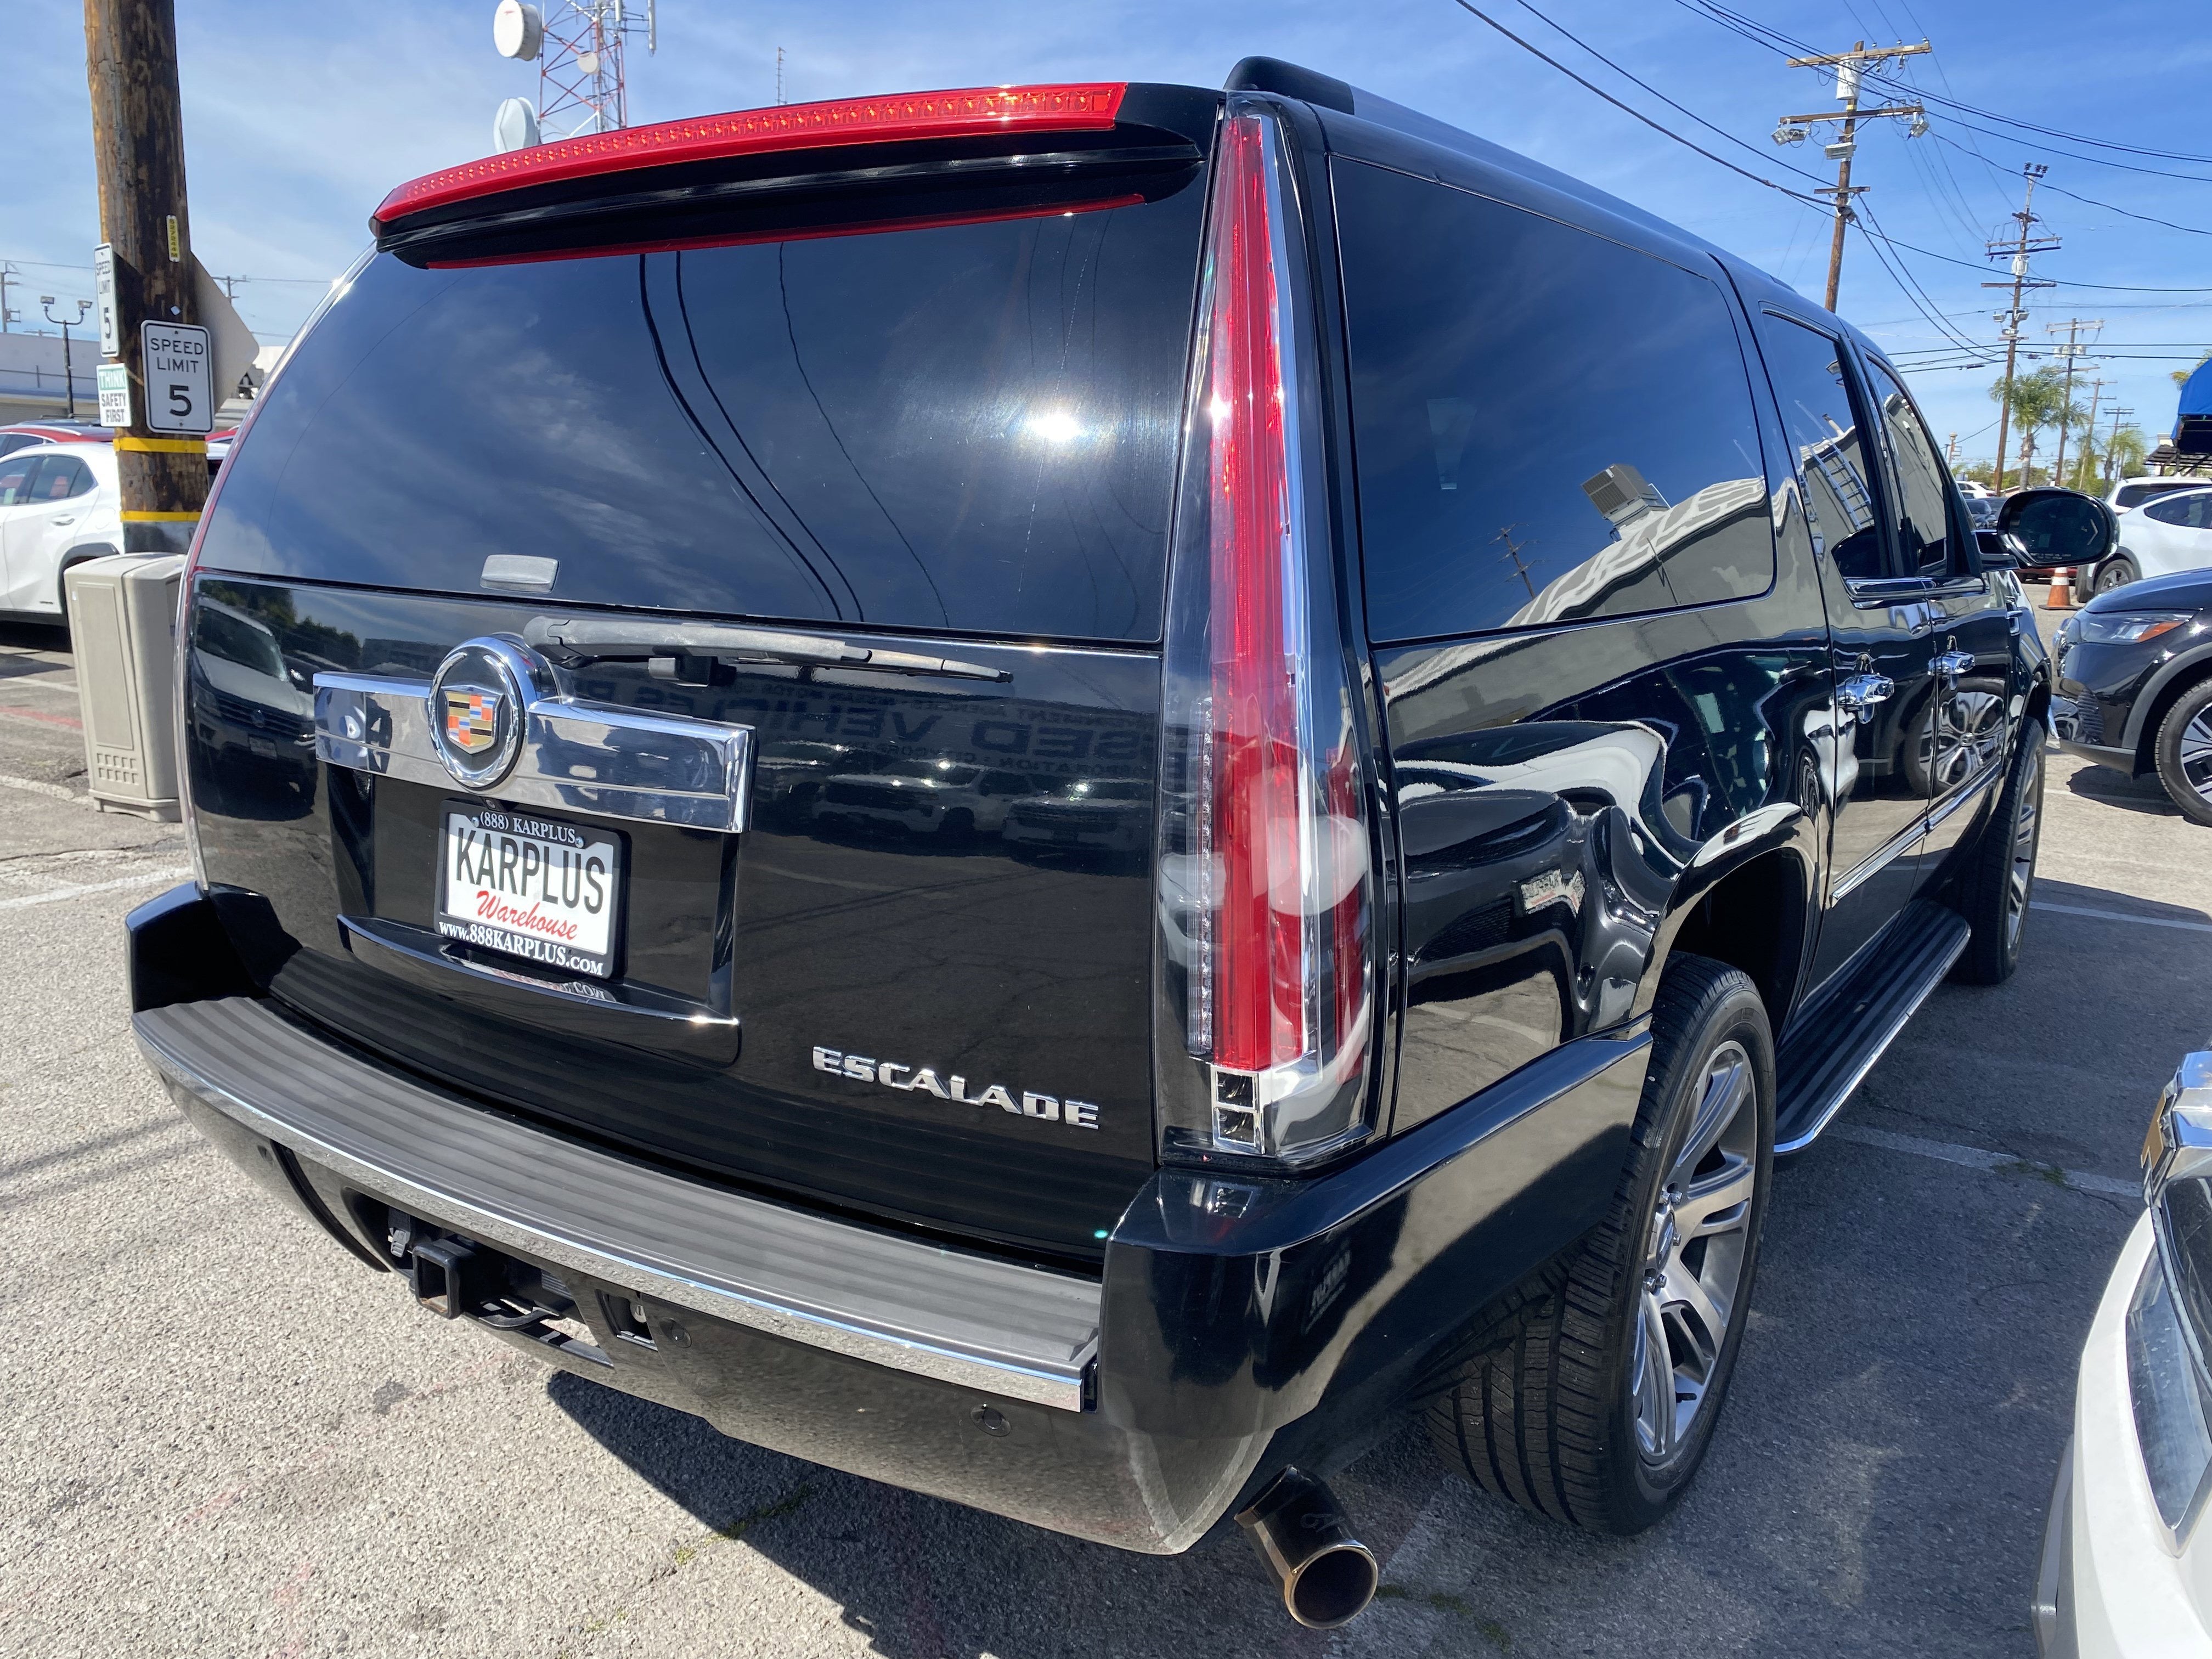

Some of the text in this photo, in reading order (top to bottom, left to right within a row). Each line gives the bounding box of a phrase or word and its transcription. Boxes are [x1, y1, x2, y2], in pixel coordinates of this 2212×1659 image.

[96, 260, 110, 275] SPEED
[99, 280, 110, 295] LIMIT
[103, 307, 111, 339] 5
[150, 338, 204, 355] SPEED
[156, 357, 199, 373] LIMIT
[99, 370, 126, 389] THINK
[101, 393, 126, 409] SAFETY
[169, 384, 192, 416] 5
[105, 409, 125, 423] FIRST
[479, 811, 576, 844] (888) KARPLUS
[456, 827, 606, 915] KARPLUS
[476, 890, 578, 940] Warehouse
[439, 921, 604, 976] www.888KARPLUS.COM
[812, 1046, 1099, 1130] ESCALADE
